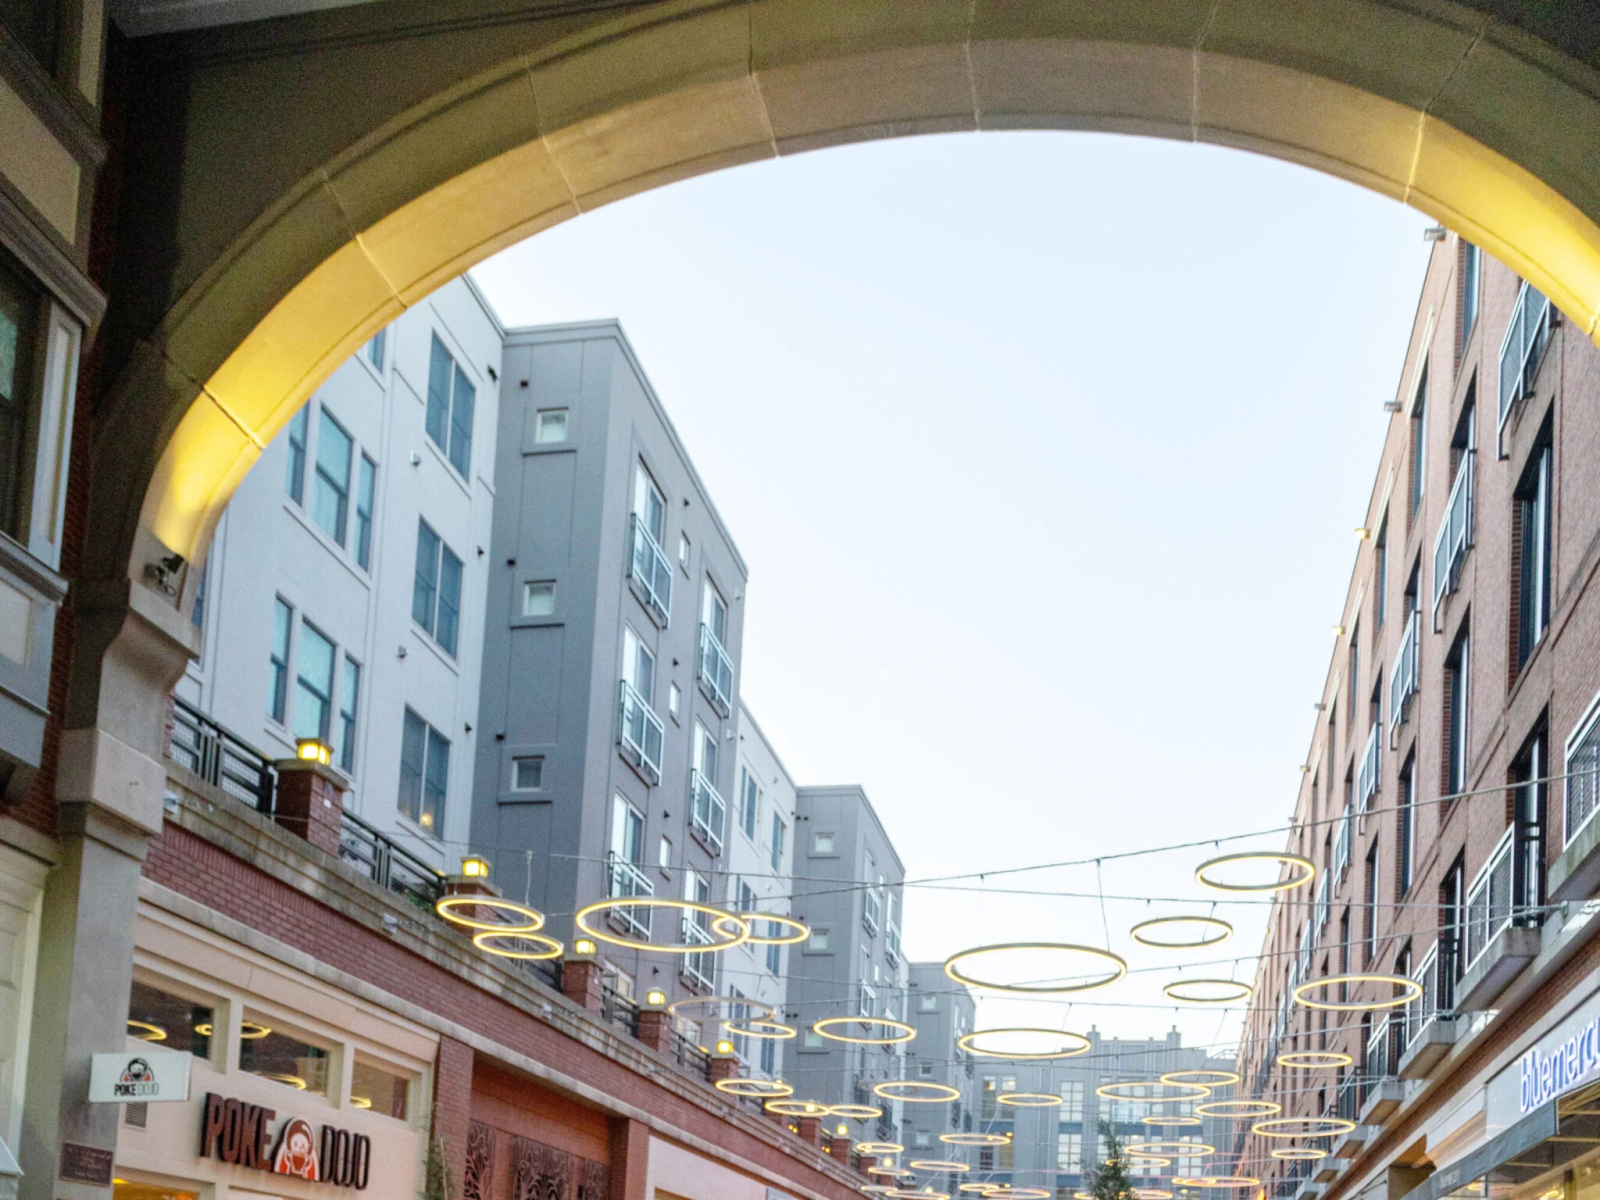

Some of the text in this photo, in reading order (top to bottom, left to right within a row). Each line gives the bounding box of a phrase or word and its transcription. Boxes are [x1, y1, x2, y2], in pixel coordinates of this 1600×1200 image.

[114, 1083, 159, 1096] POKE DOJO
[1520, 1014, 1600, 1114] bluemerc
[200, 1092, 371, 1190] POKE DOJO
